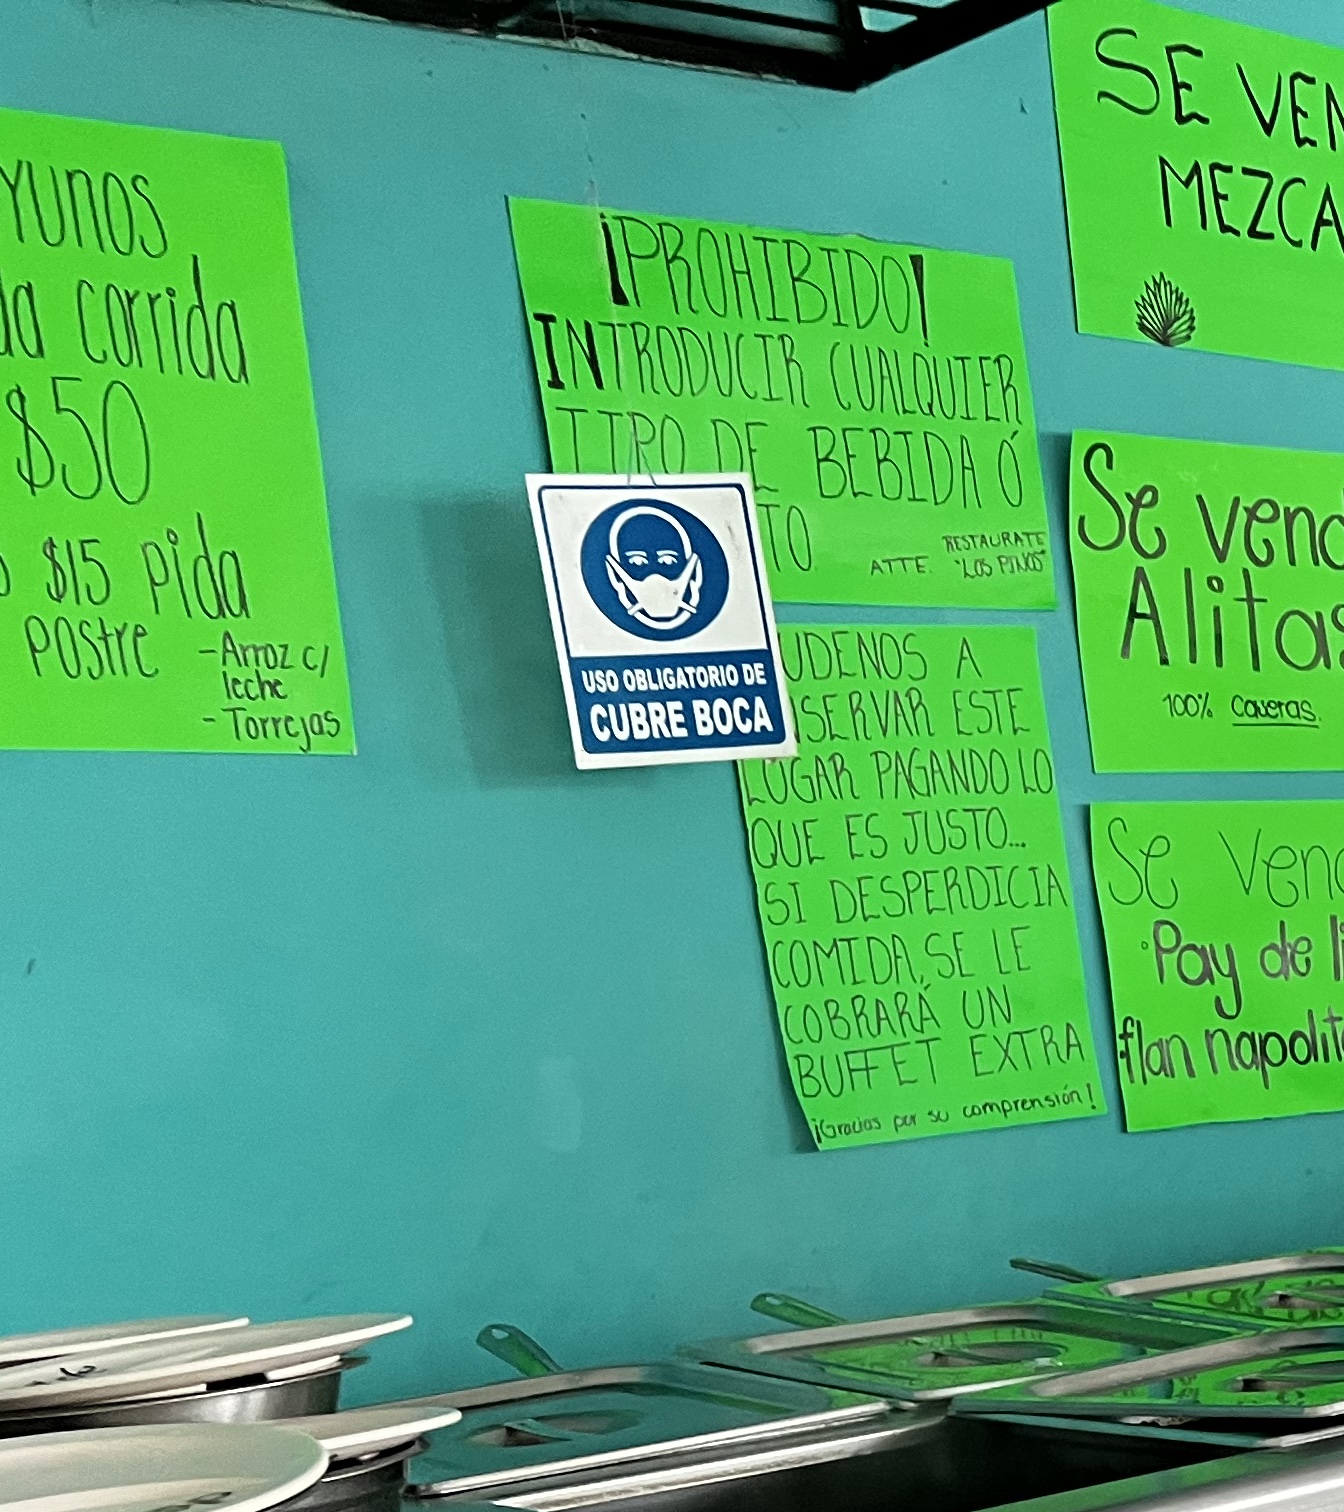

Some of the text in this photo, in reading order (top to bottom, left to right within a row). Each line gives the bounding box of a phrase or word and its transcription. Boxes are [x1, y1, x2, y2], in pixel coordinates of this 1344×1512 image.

[1095, 27, 1210, 126] SE
[599, 212, 930, 347] ¡PROHIBIDO!
[79, 254, 249, 385] corrida
[533, 313, 1022, 425] INTRODUCIR CUALQUIER
[8, 377, 150, 504] $50
[711, 419, 779, 492] DE
[807, 426, 982, 508] BEBIDA
[1078, 442, 1167, 560] Se
[42, 537, 111, 605] $15
[222, 669, 287, 701] leche
[303, 645, 329, 678] c/
[582, 663, 767, 693] USO OBLIGATORIO DE
[778, 630, 982, 683] UDENOS A
[589, 696, 774, 742] CUBRE BOCA
[790, 687, 1031, 743] SERVAR ESTE
[1162, 692, 1213, 719] 100%
[741, 747, 1054, 808] LUGAR PAGANDO LO
[750, 817, 826, 870] QUE
[845, 814, 889, 860] ES
[1107, 817, 1179, 909] Se
[766, 864, 1069, 927] SI DESPERDICIA
[924, 930, 976, 980] SE
[992, 926, 1032, 974] LE
[1153, 919, 1243, 1020] Pay
[1259, 920, 1313, 982] de
[961, 985, 1012, 1029] UN
[793, 1024, 1086, 1100] BUFFET EXTRA
[1119, 1016, 1196, 1085] flan
[893, 1113, 918, 1134] por
[927, 1110, 949, 1123] su
